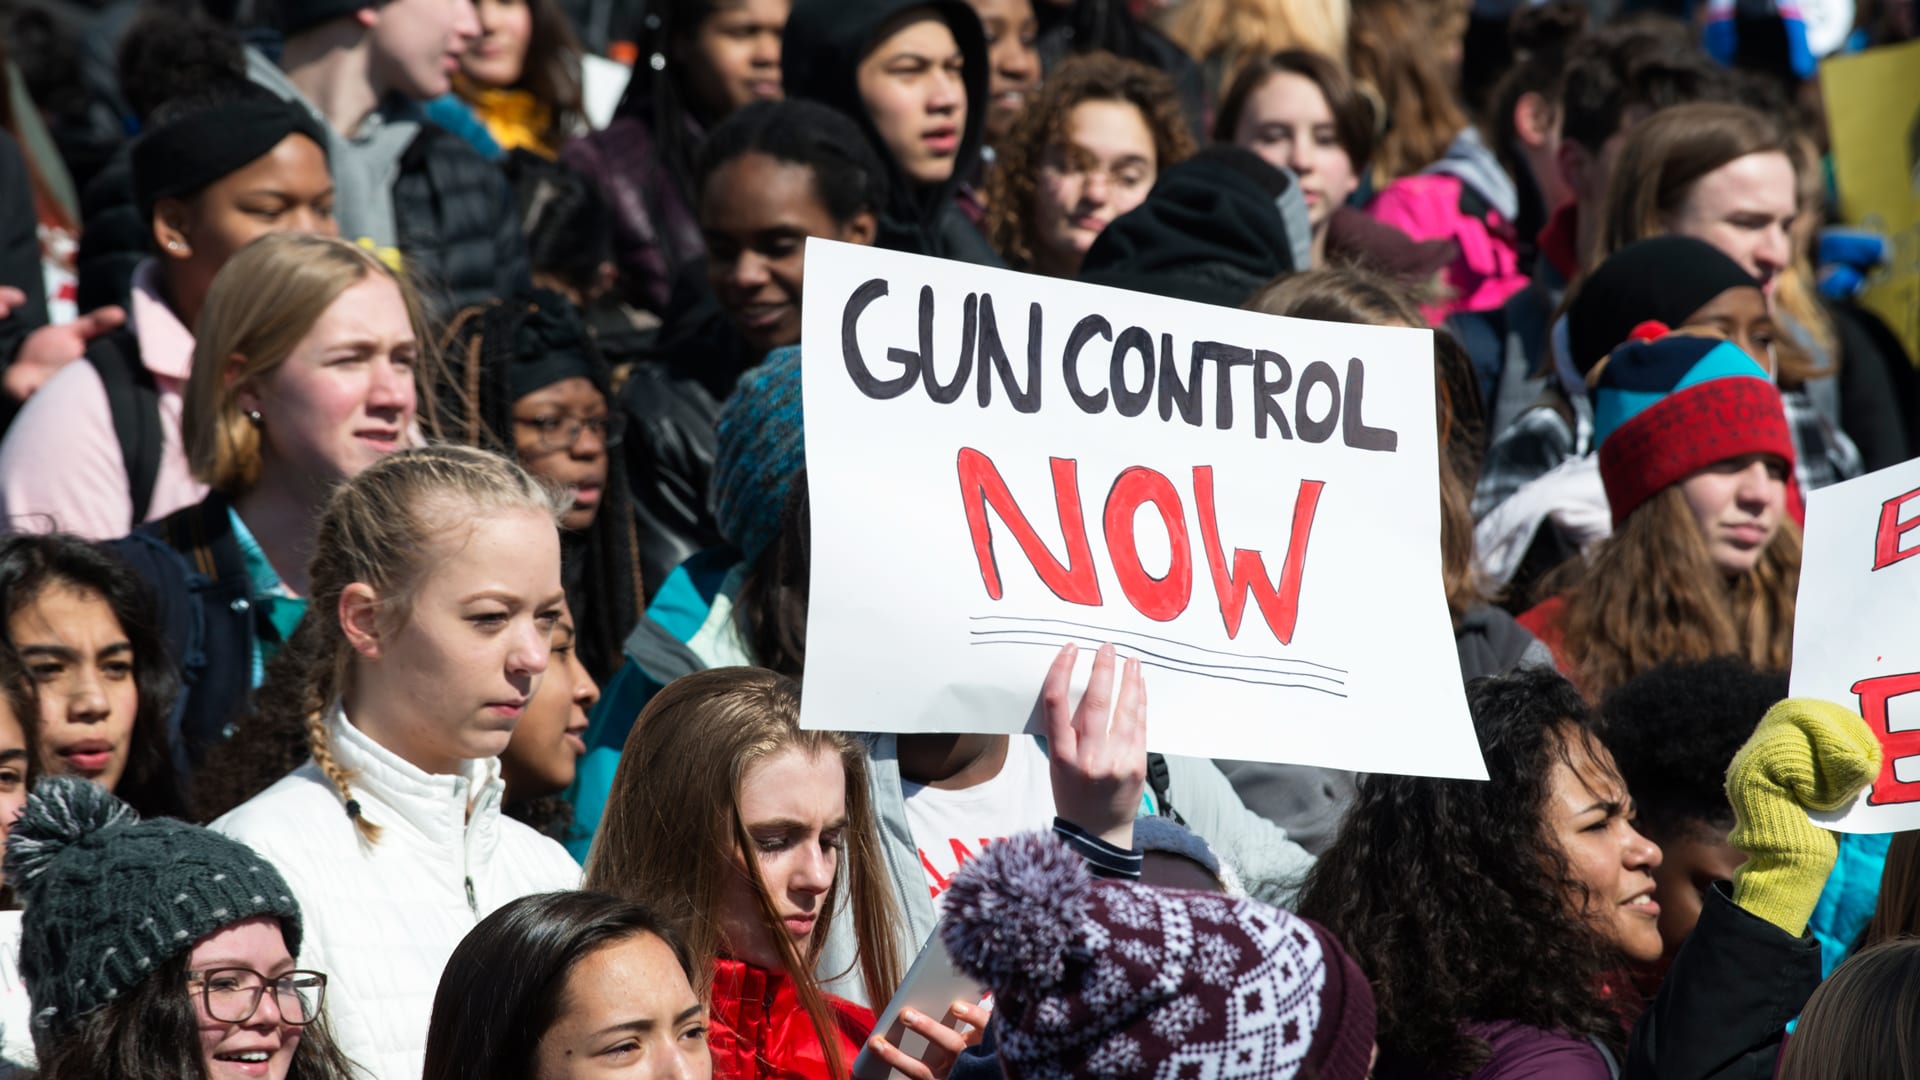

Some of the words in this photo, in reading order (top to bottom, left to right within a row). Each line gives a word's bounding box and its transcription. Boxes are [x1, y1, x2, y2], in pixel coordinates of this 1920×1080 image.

[841, 278, 1042, 414] GUN
[1062, 313, 1398, 452] CONTROL
[957, 447, 1326, 645] NOW
